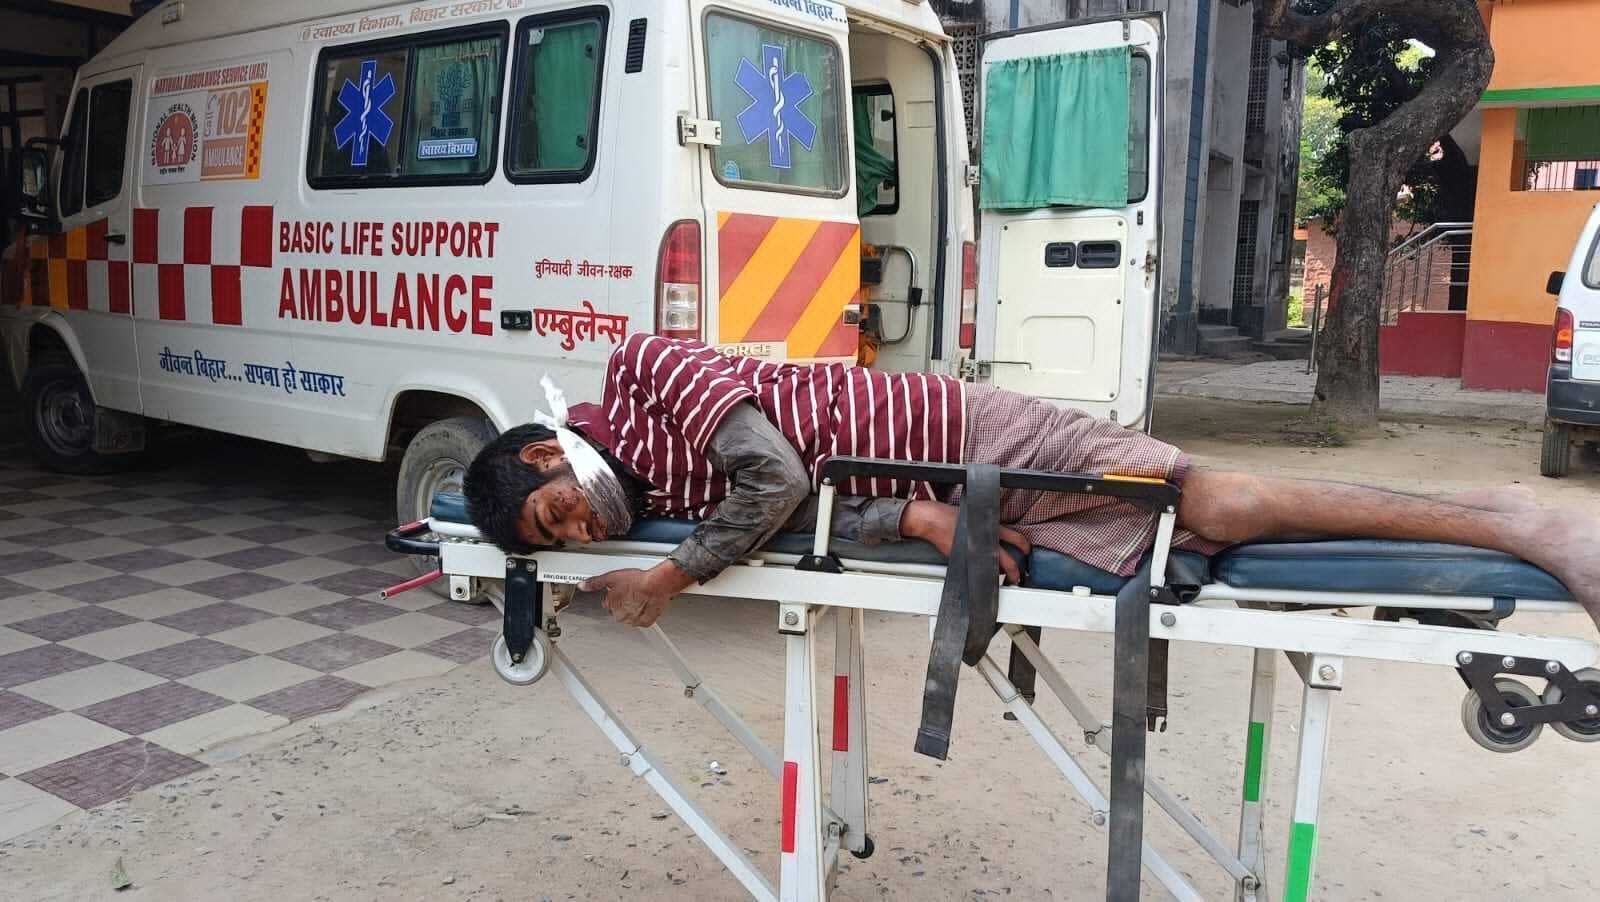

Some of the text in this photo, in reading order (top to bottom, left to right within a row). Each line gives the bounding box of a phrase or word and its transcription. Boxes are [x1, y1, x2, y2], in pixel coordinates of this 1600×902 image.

[184, 70, 221, 89] AMBULANCE
[222, 66, 248, 84] SERVICE
[151, 103, 199, 166] NATIONAL HEALTH MISSION
[216, 90, 250, 136] 102
[279, 221, 499, 258] BASIC LIFE SUPPORT
[278, 267, 494, 336] AMBULANCE
[533, 300, 629, 351] एम्बुलेन्स
[159, 346, 193, 375] जीवन्त
[244, 362, 281, 388] सपना
[281, 361, 297, 394] हो
[299, 370, 347, 397] साकार
